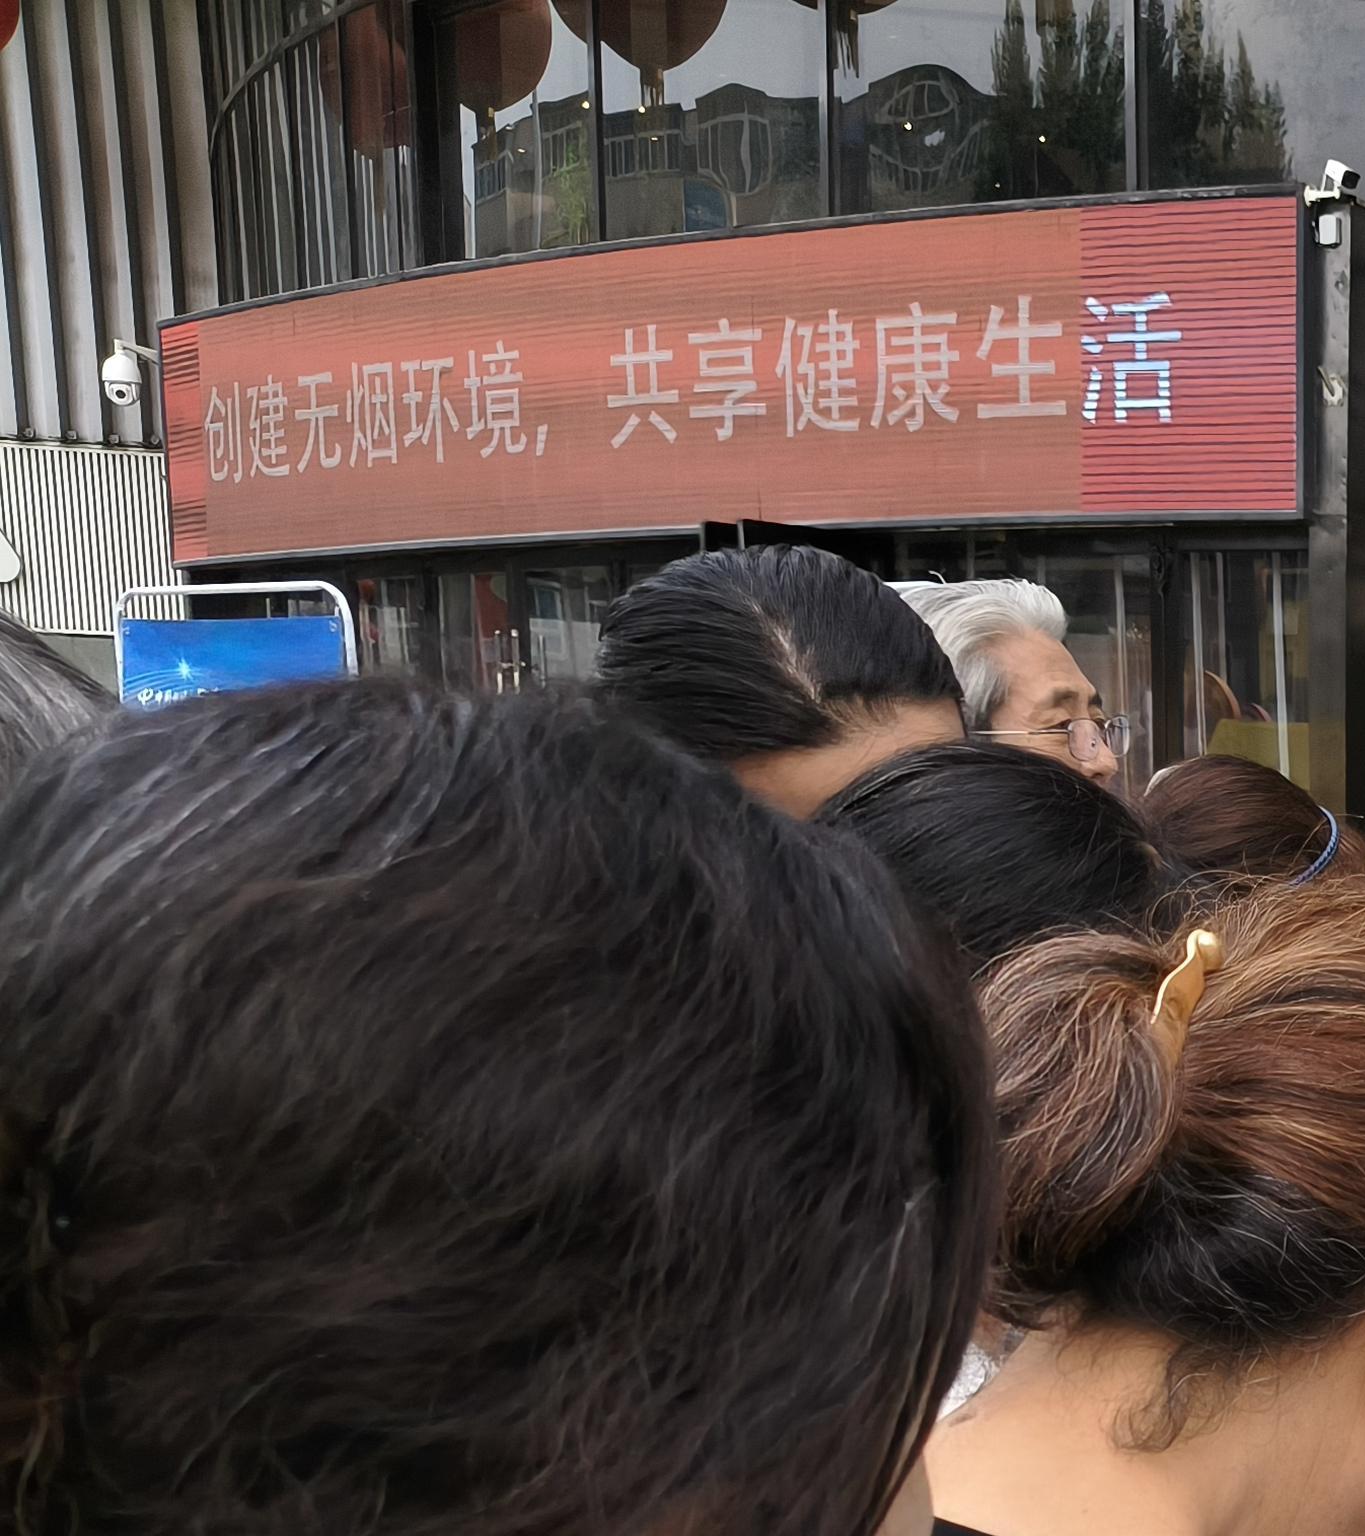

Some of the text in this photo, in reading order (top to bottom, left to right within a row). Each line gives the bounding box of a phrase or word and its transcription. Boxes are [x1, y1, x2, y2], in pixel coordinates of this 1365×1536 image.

[605, 290, 1184, 451] 共享健康生活
